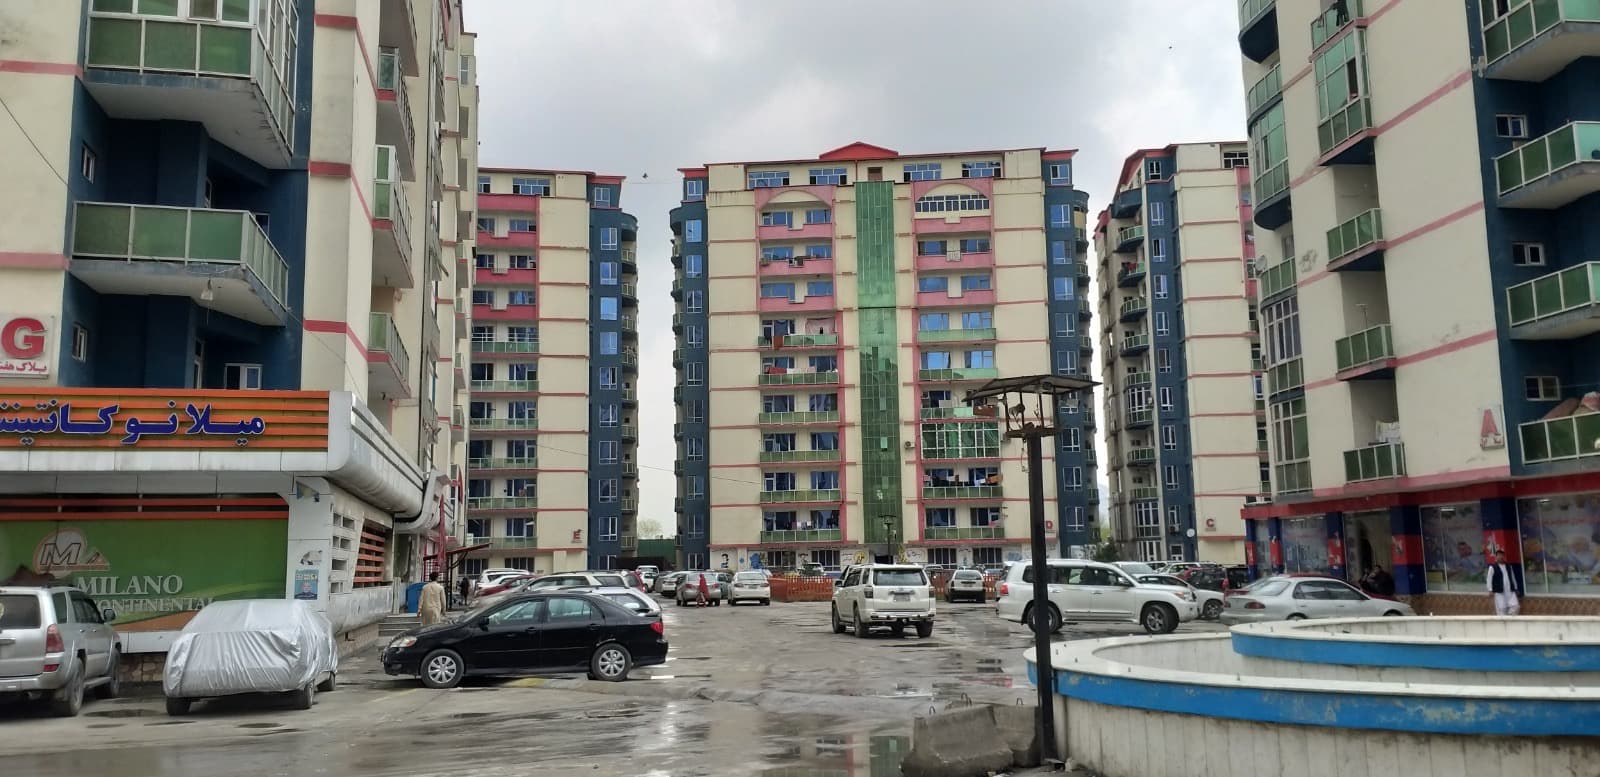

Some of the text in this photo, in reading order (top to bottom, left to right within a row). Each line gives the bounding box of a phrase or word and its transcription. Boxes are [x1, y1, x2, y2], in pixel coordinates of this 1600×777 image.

[1, 317, 46, 359] G
[1481, 408, 1500, 437] A
[1206, 518, 1215, 528] C
[573, 529, 582, 541] E
[76, 574, 183, 596] MILANO
[95, 597, 213, 613] ONTINENTA
